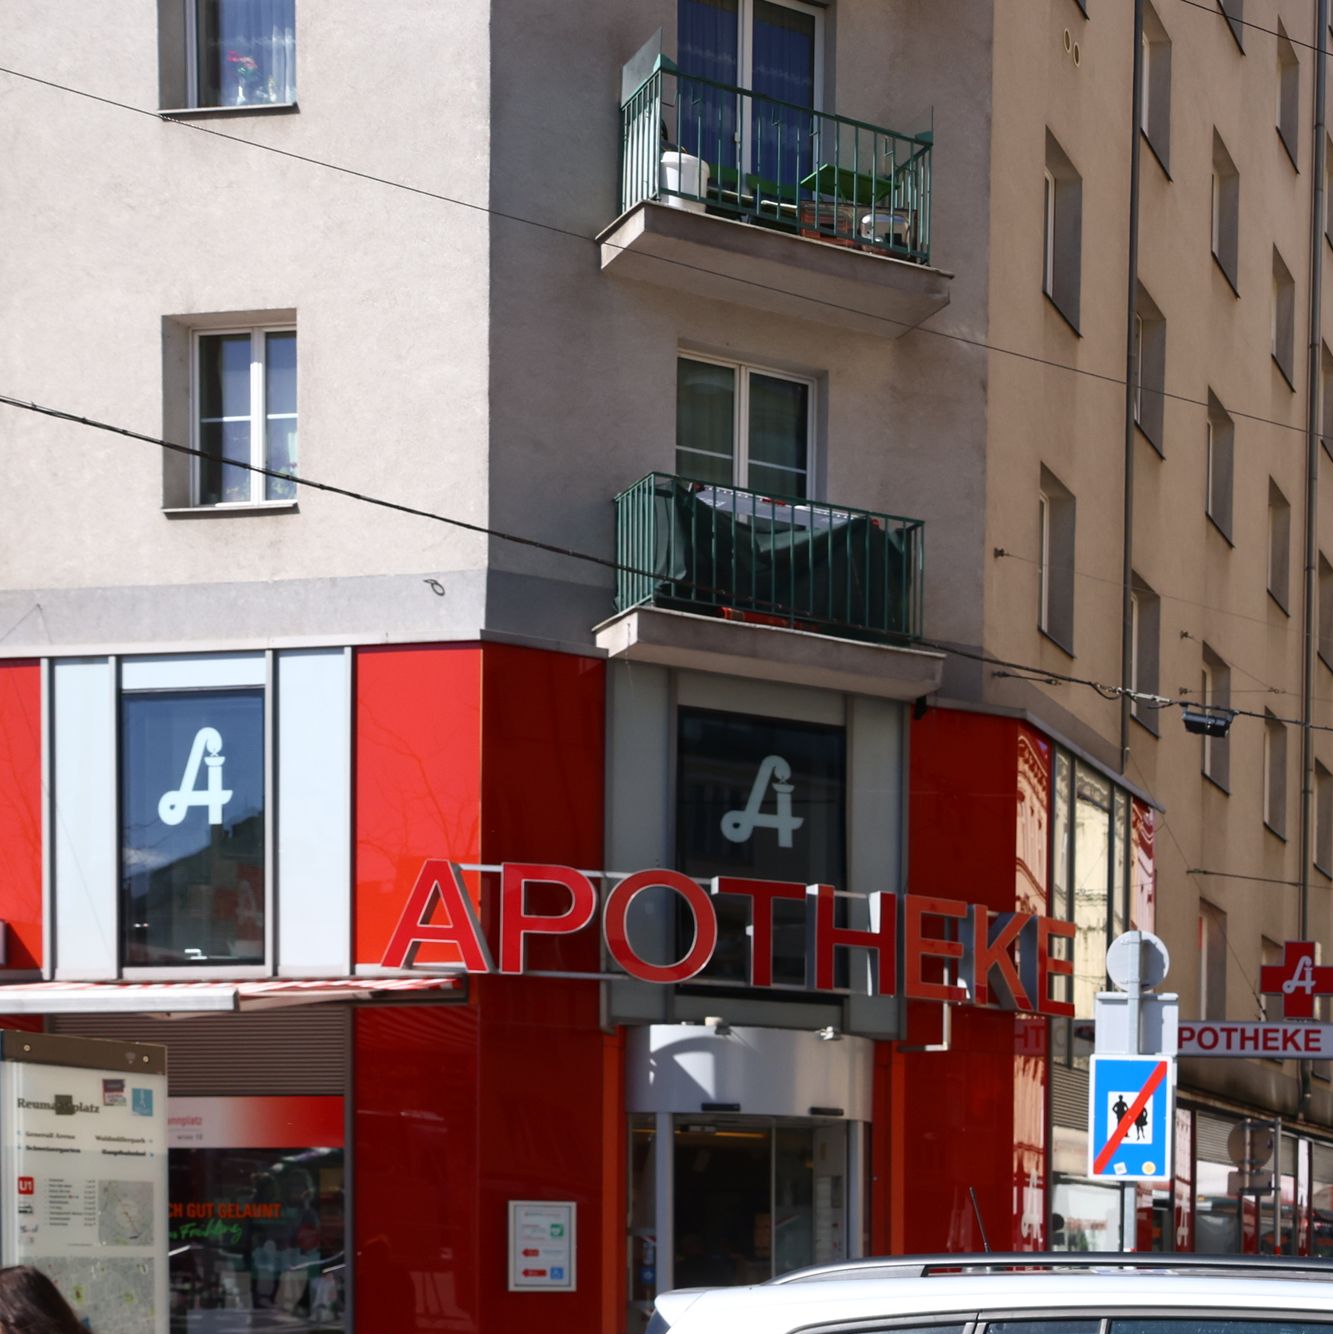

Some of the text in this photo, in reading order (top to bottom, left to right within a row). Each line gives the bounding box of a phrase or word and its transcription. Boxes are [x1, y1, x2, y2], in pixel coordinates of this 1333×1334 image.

[381, 858, 1076, 1018] APOTHEKE
[1178, 1027, 1322, 1052] POTHEKE
[19, 1180, 33, 1191] U1
